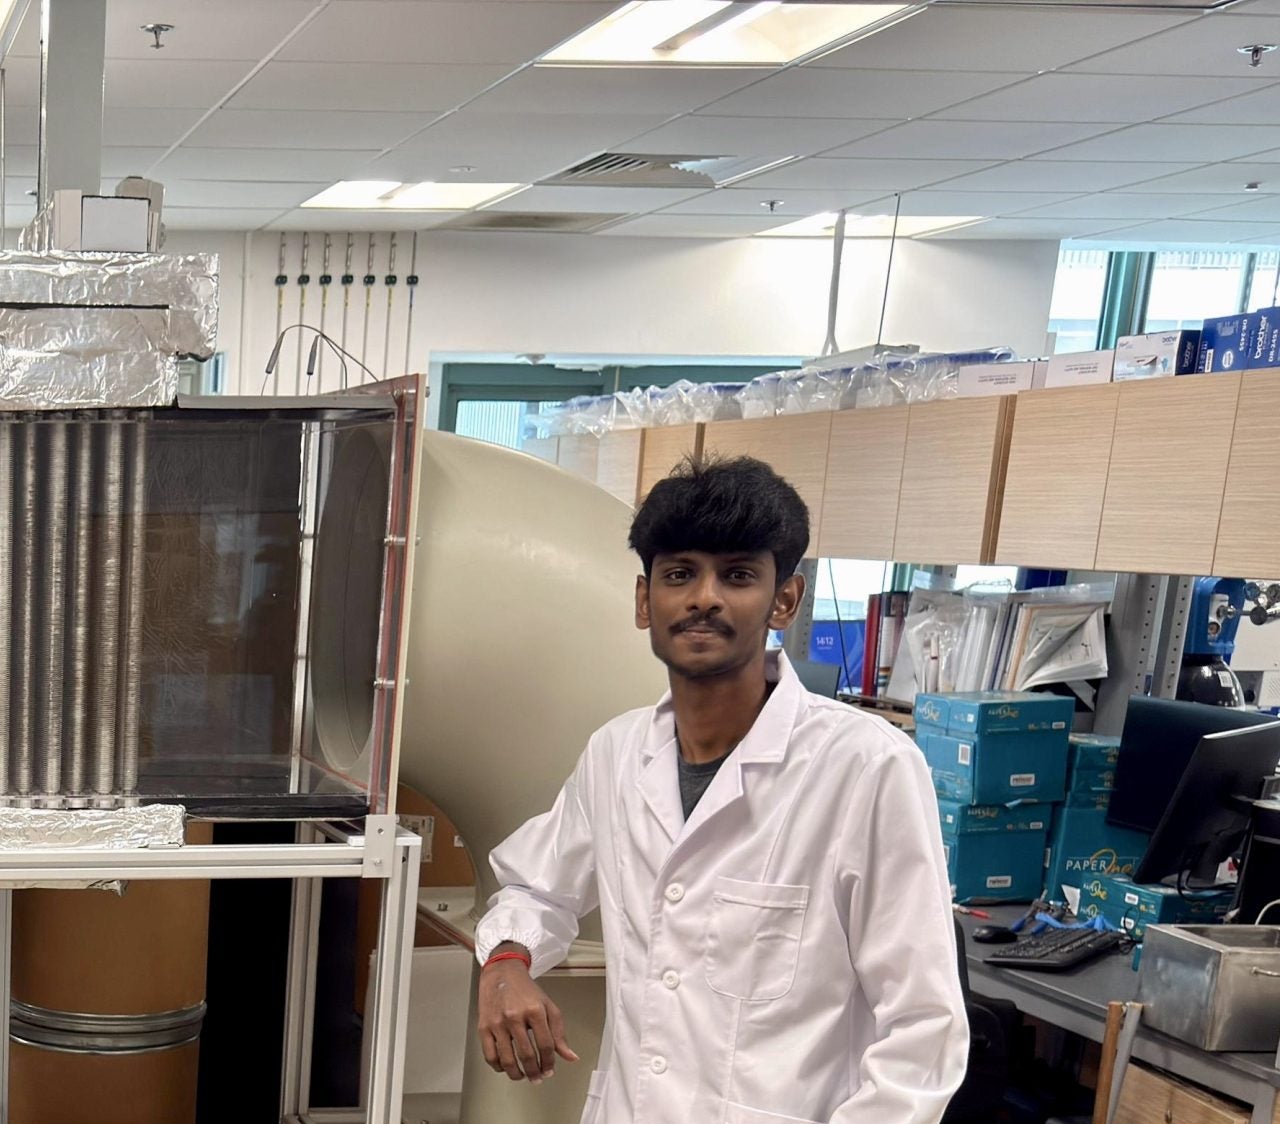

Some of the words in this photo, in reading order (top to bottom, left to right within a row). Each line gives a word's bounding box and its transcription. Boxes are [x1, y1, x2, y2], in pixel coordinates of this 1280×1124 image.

[1254, 315, 1267, 359] brother
[1065, 859, 1106, 872] PAPER
[1089, 848, 1134, 875] One
